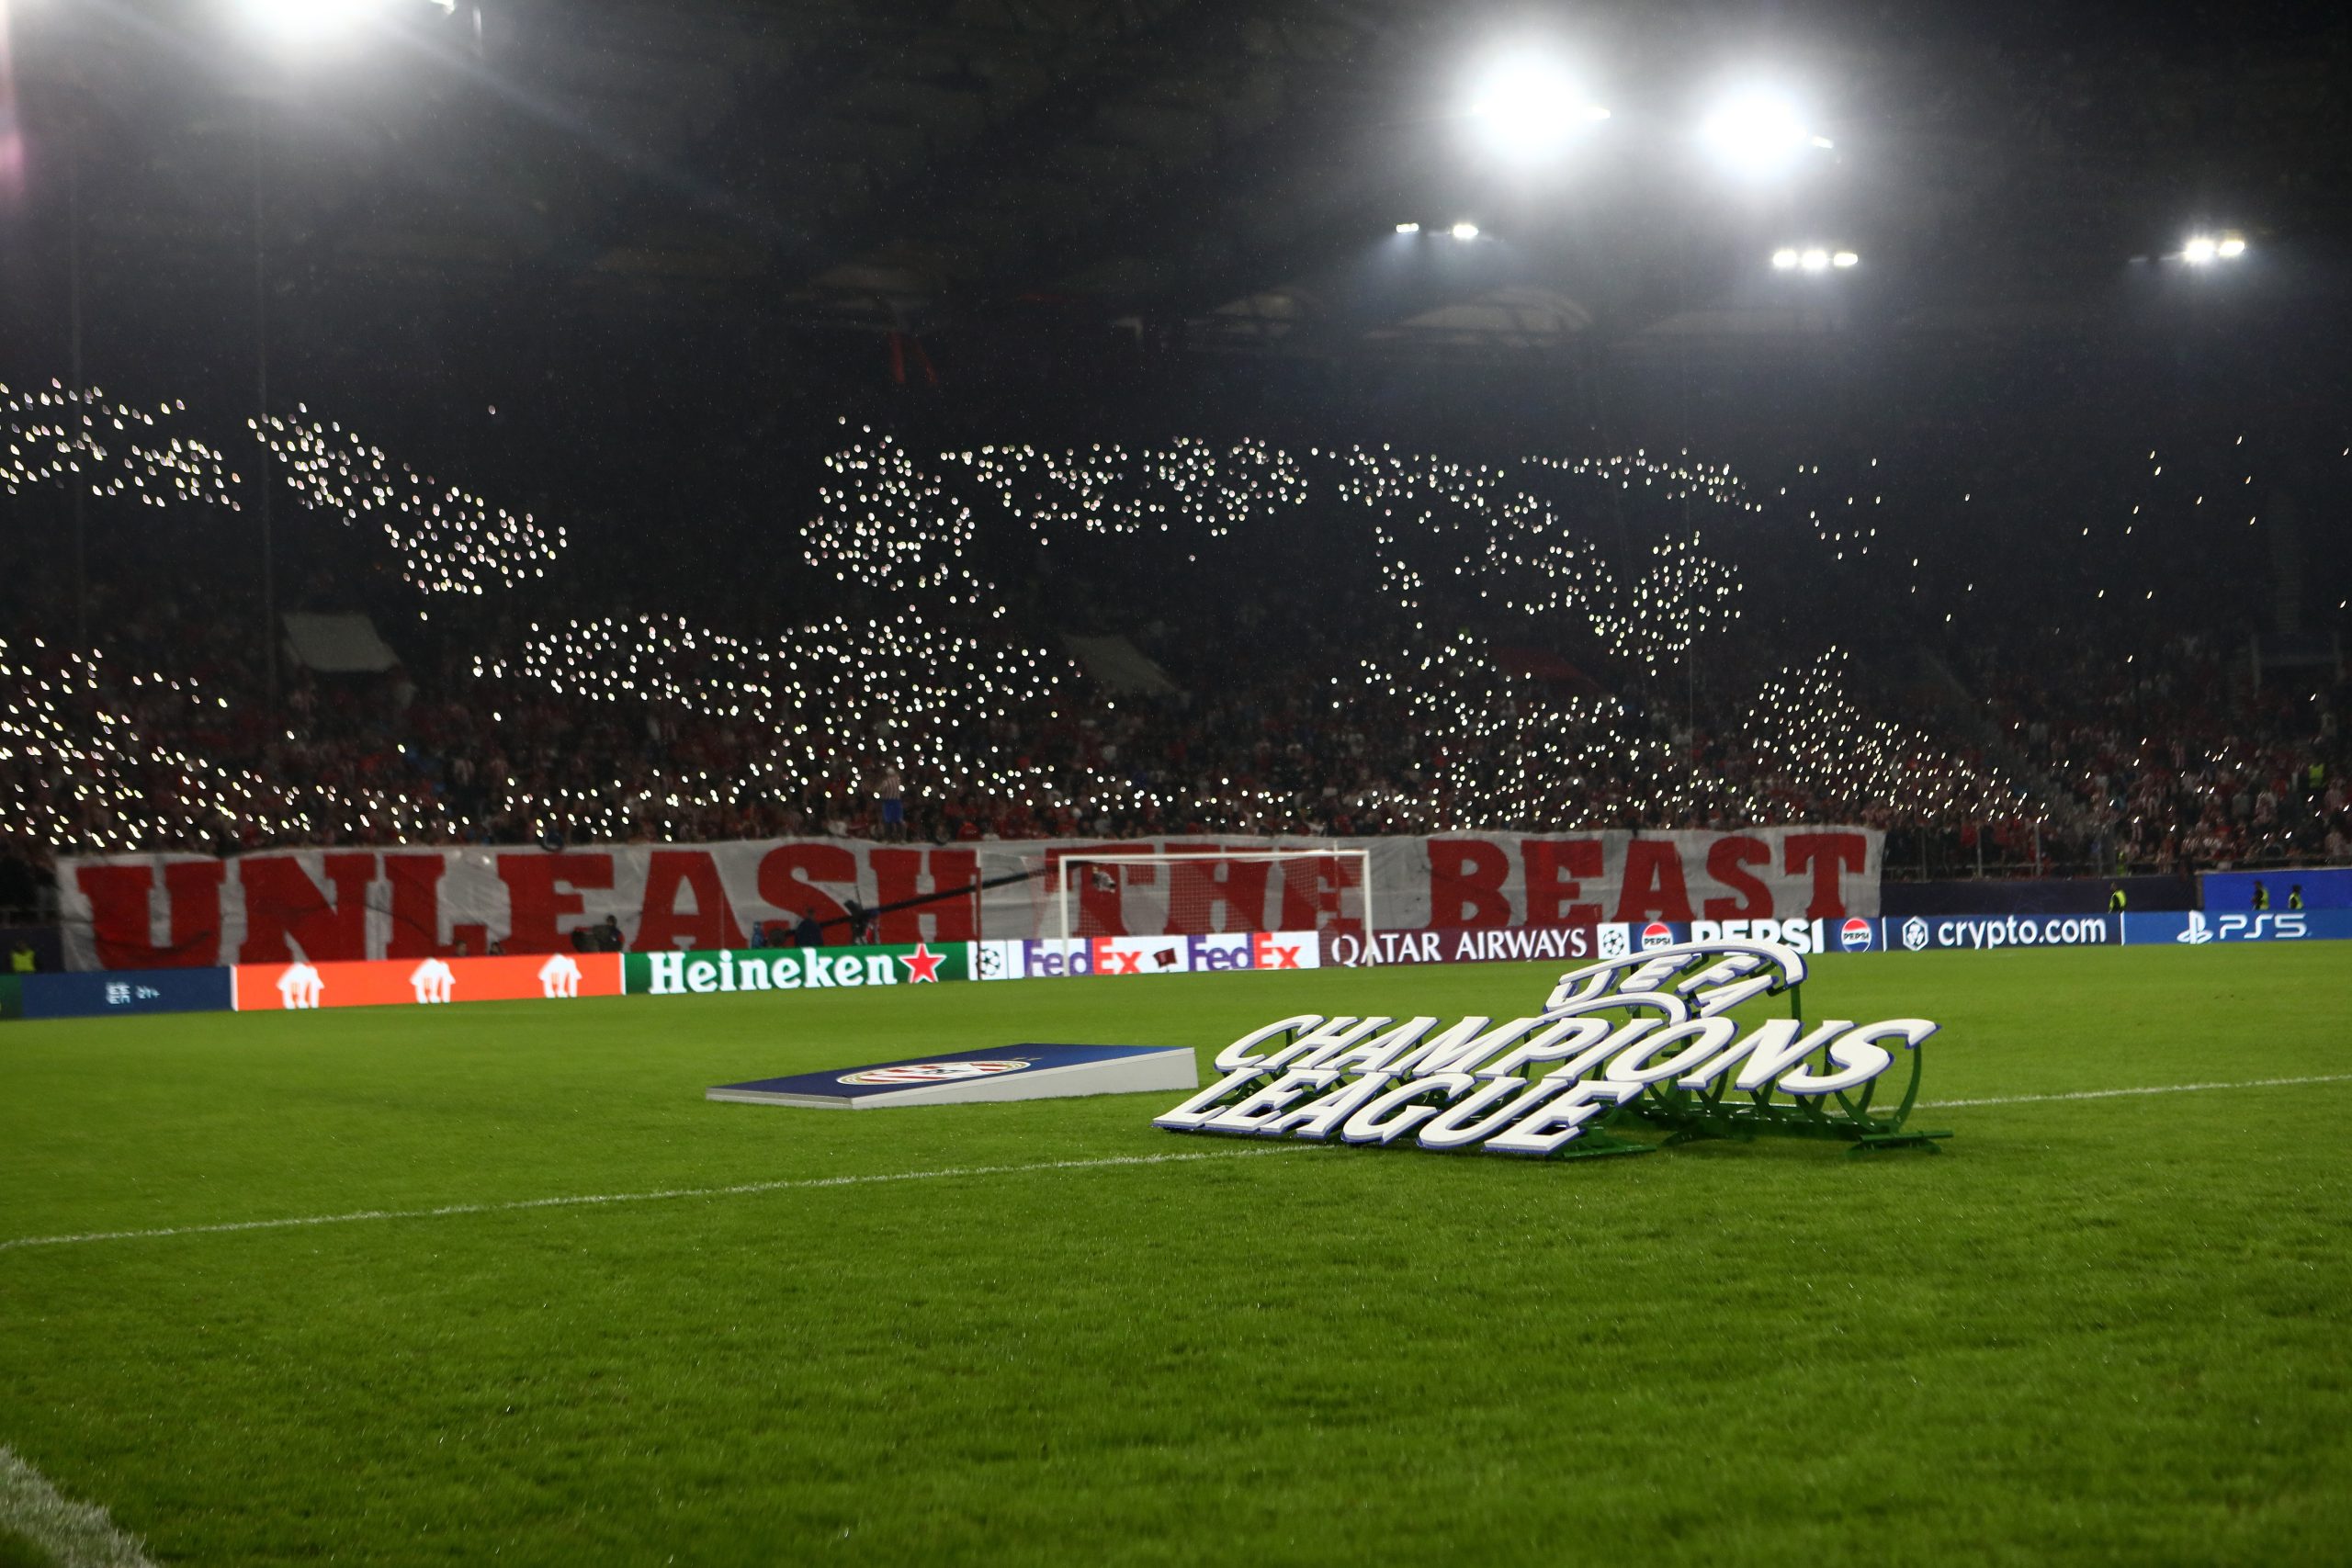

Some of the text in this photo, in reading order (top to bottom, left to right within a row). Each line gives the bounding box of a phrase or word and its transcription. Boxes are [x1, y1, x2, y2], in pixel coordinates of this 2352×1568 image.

[77, 844, 977, 969] UNLEASH
[1427, 836, 1866, 930] BEAST
[1643, 937, 1671, 946] PEPSI
[1843, 931, 1870, 941] PEPSI
[1938, 915, 2106, 950] crypto.com
[2219, 913, 2307, 940] PS5
[1023, 937, 1143, 977] FedEx
[1187, 932, 1301, 972] FedEx
[1331, 928, 1588, 967] QATAR AIRWAYS
[648, 947, 898, 995] Heineken
[1544, 953, 1778, 1020] UEFA
[1214, 1015, 1941, 1094] CHAMPIONS
[1152, 1067, 1646, 1156] LEAGUE
